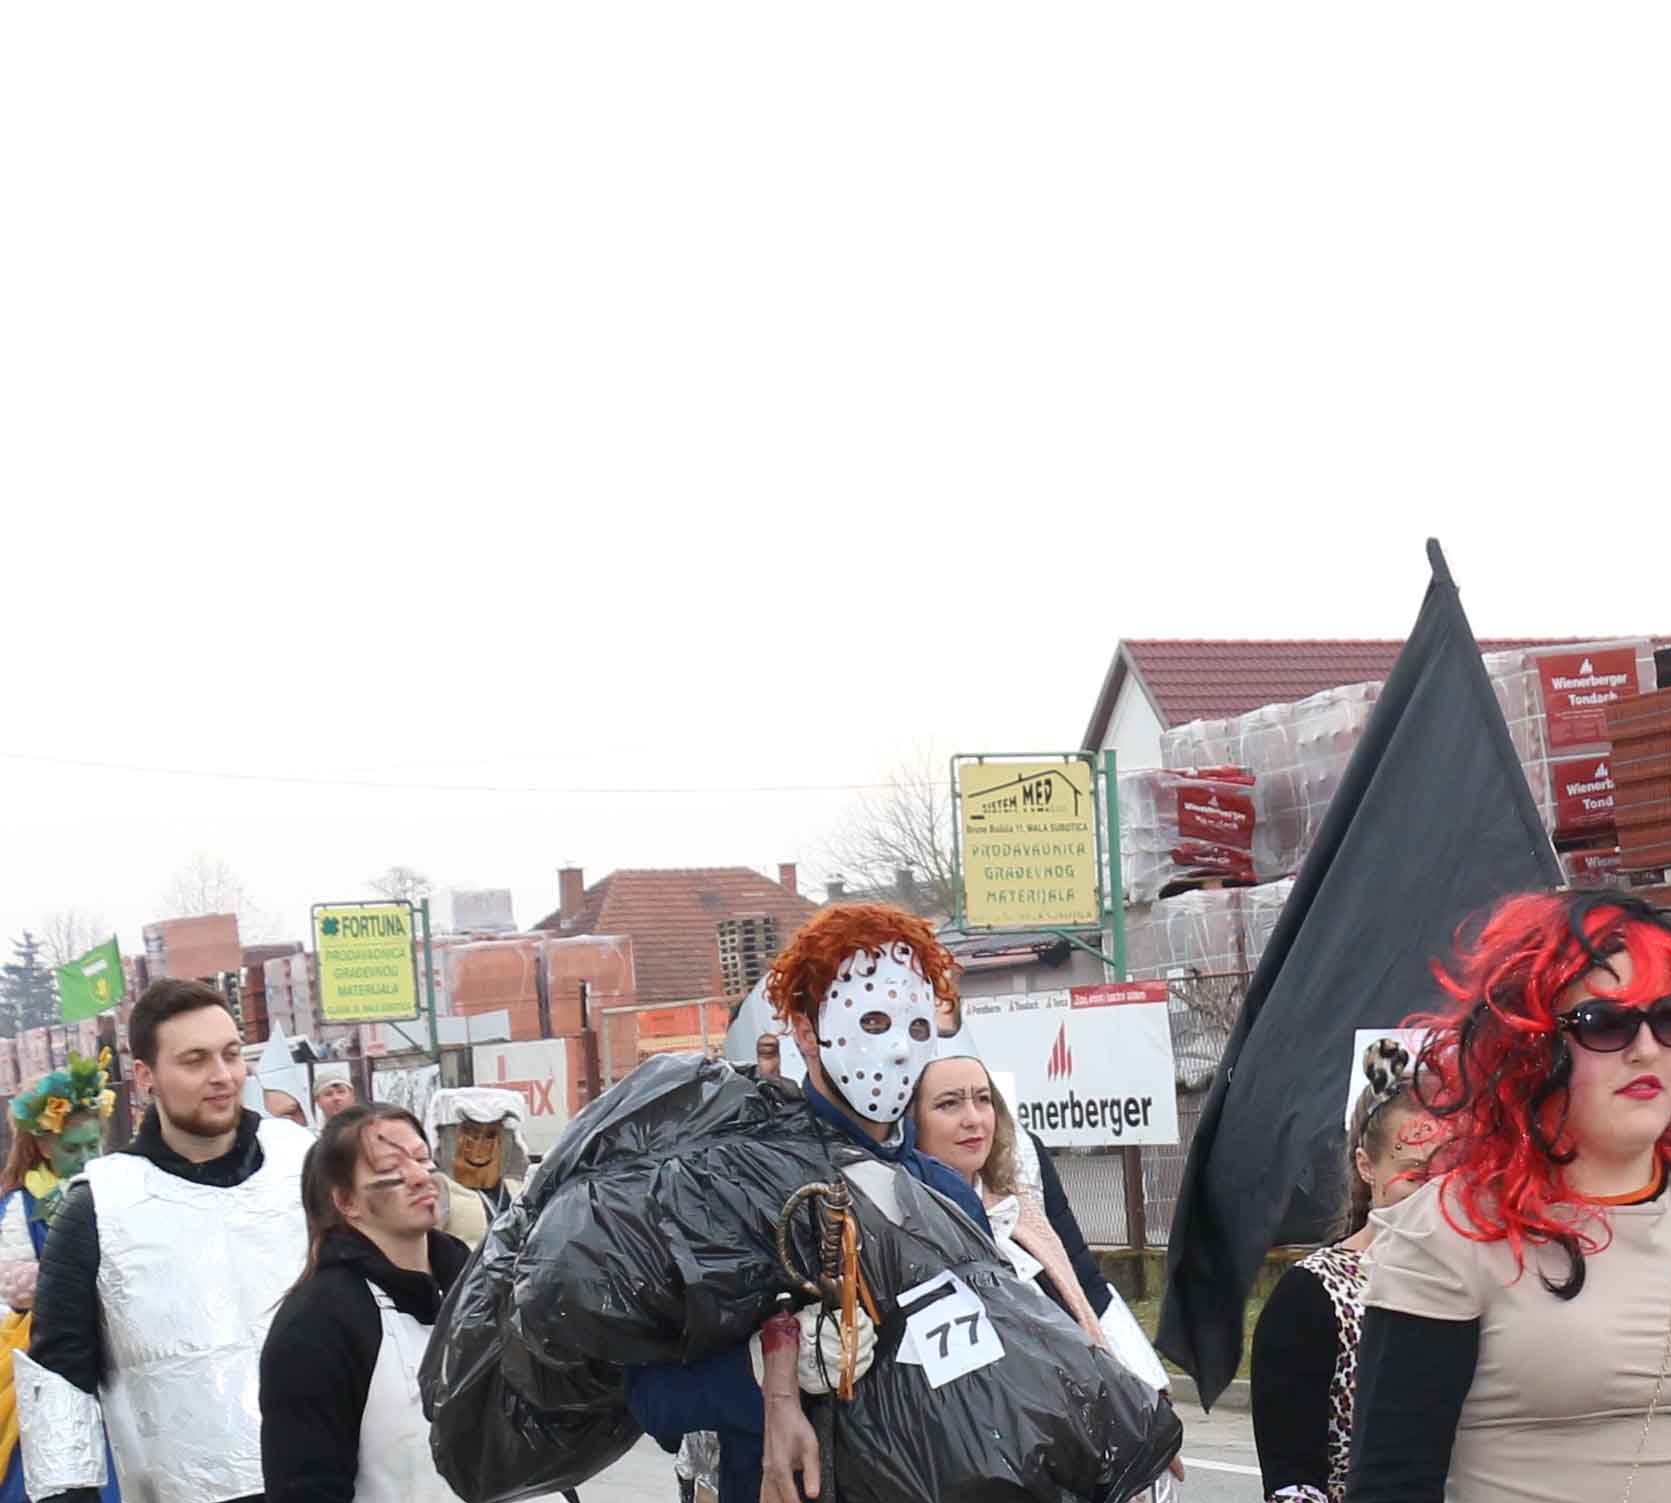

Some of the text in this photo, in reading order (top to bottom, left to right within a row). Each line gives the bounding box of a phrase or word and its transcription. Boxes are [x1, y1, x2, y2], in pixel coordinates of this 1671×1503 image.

[1552, 673, 1627, 690] Wienerberger
[342, 915, 407, 938] FORTUNA
[925, 1311, 980, 1358] 77
